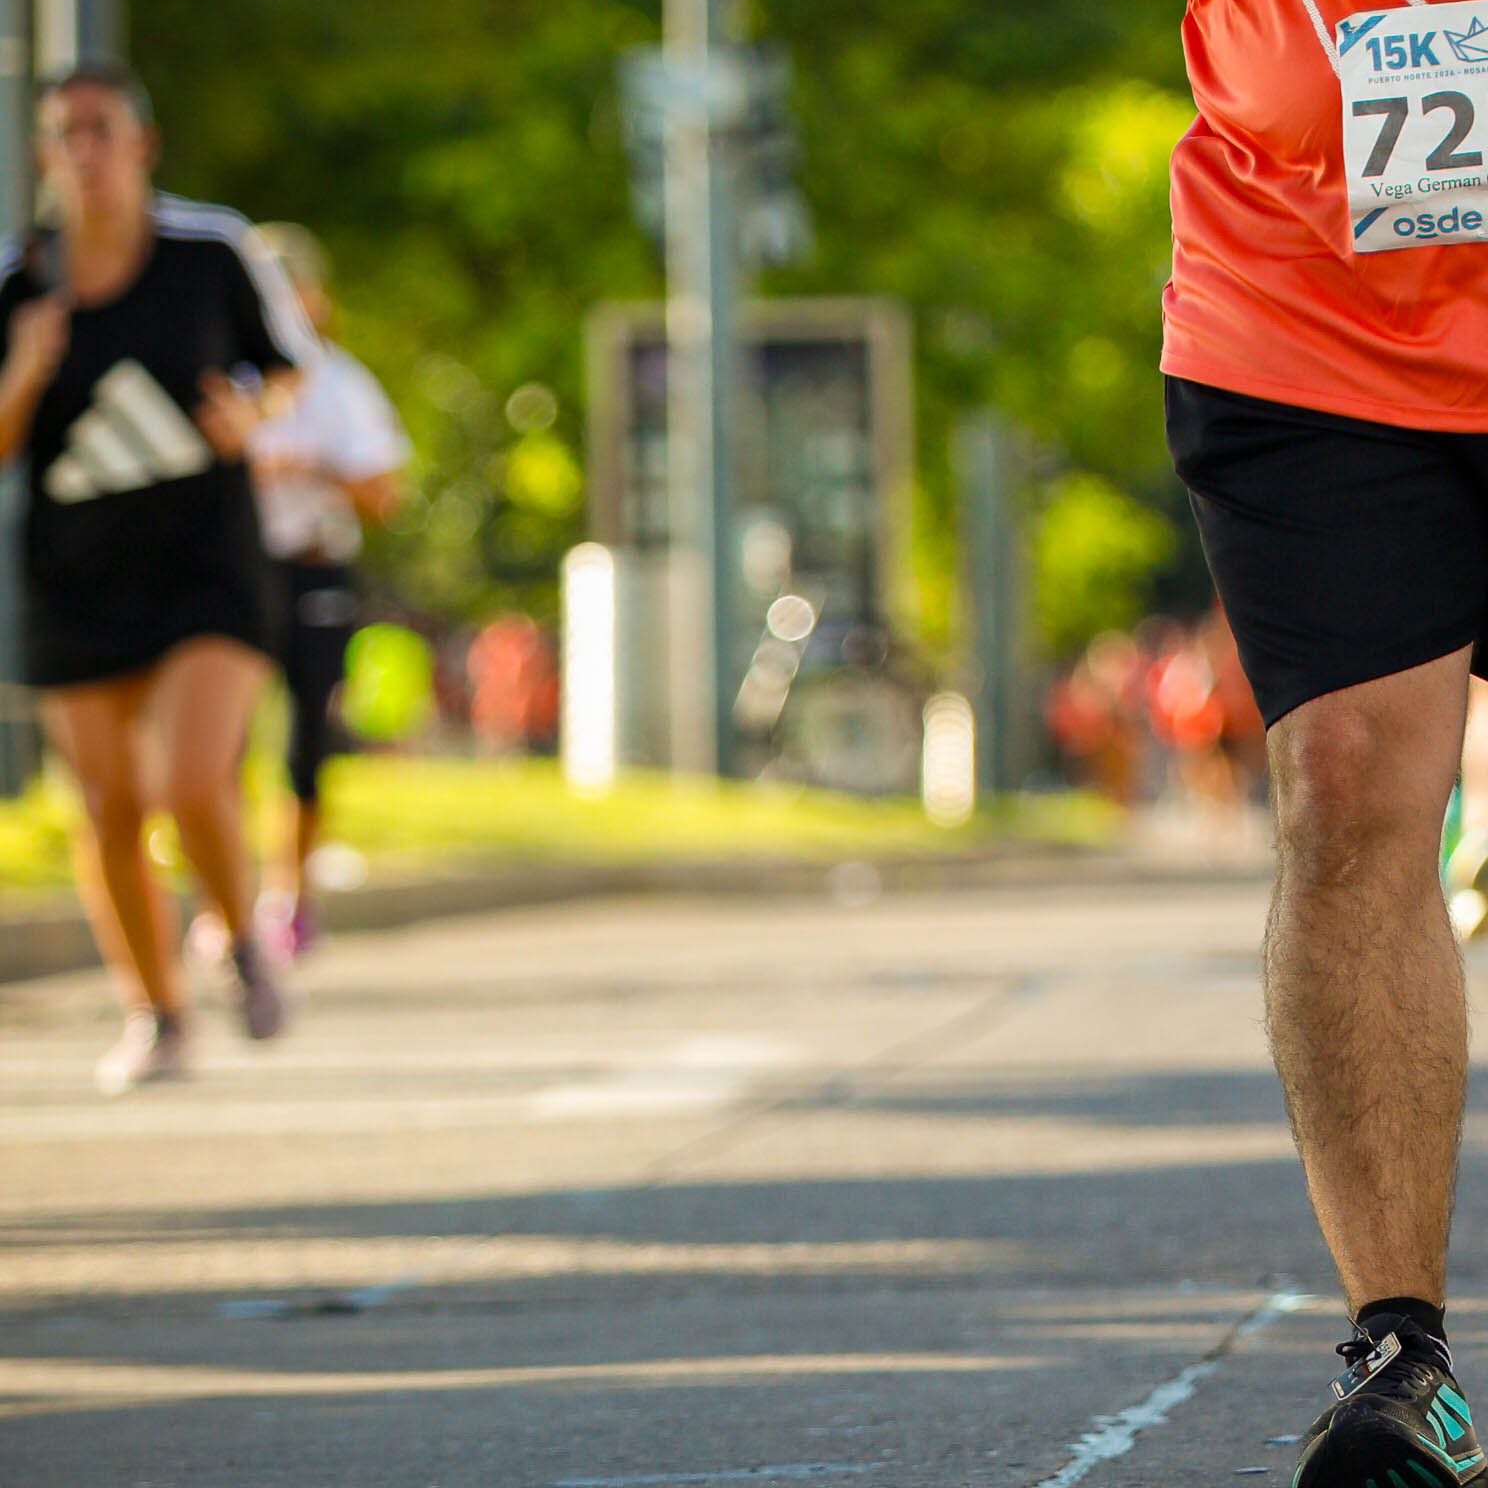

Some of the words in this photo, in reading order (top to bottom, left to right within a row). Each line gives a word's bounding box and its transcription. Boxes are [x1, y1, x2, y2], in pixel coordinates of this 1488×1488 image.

[1365, 31, 1441, 72] 15K
[1368, 74, 1401, 85] PUERTO
[1403, 71, 1432, 81] NORTE
[1370, 182, 1413, 200] Vega
[1417, 176, 1481, 193] German
[1393, 205, 1483, 239] osde
